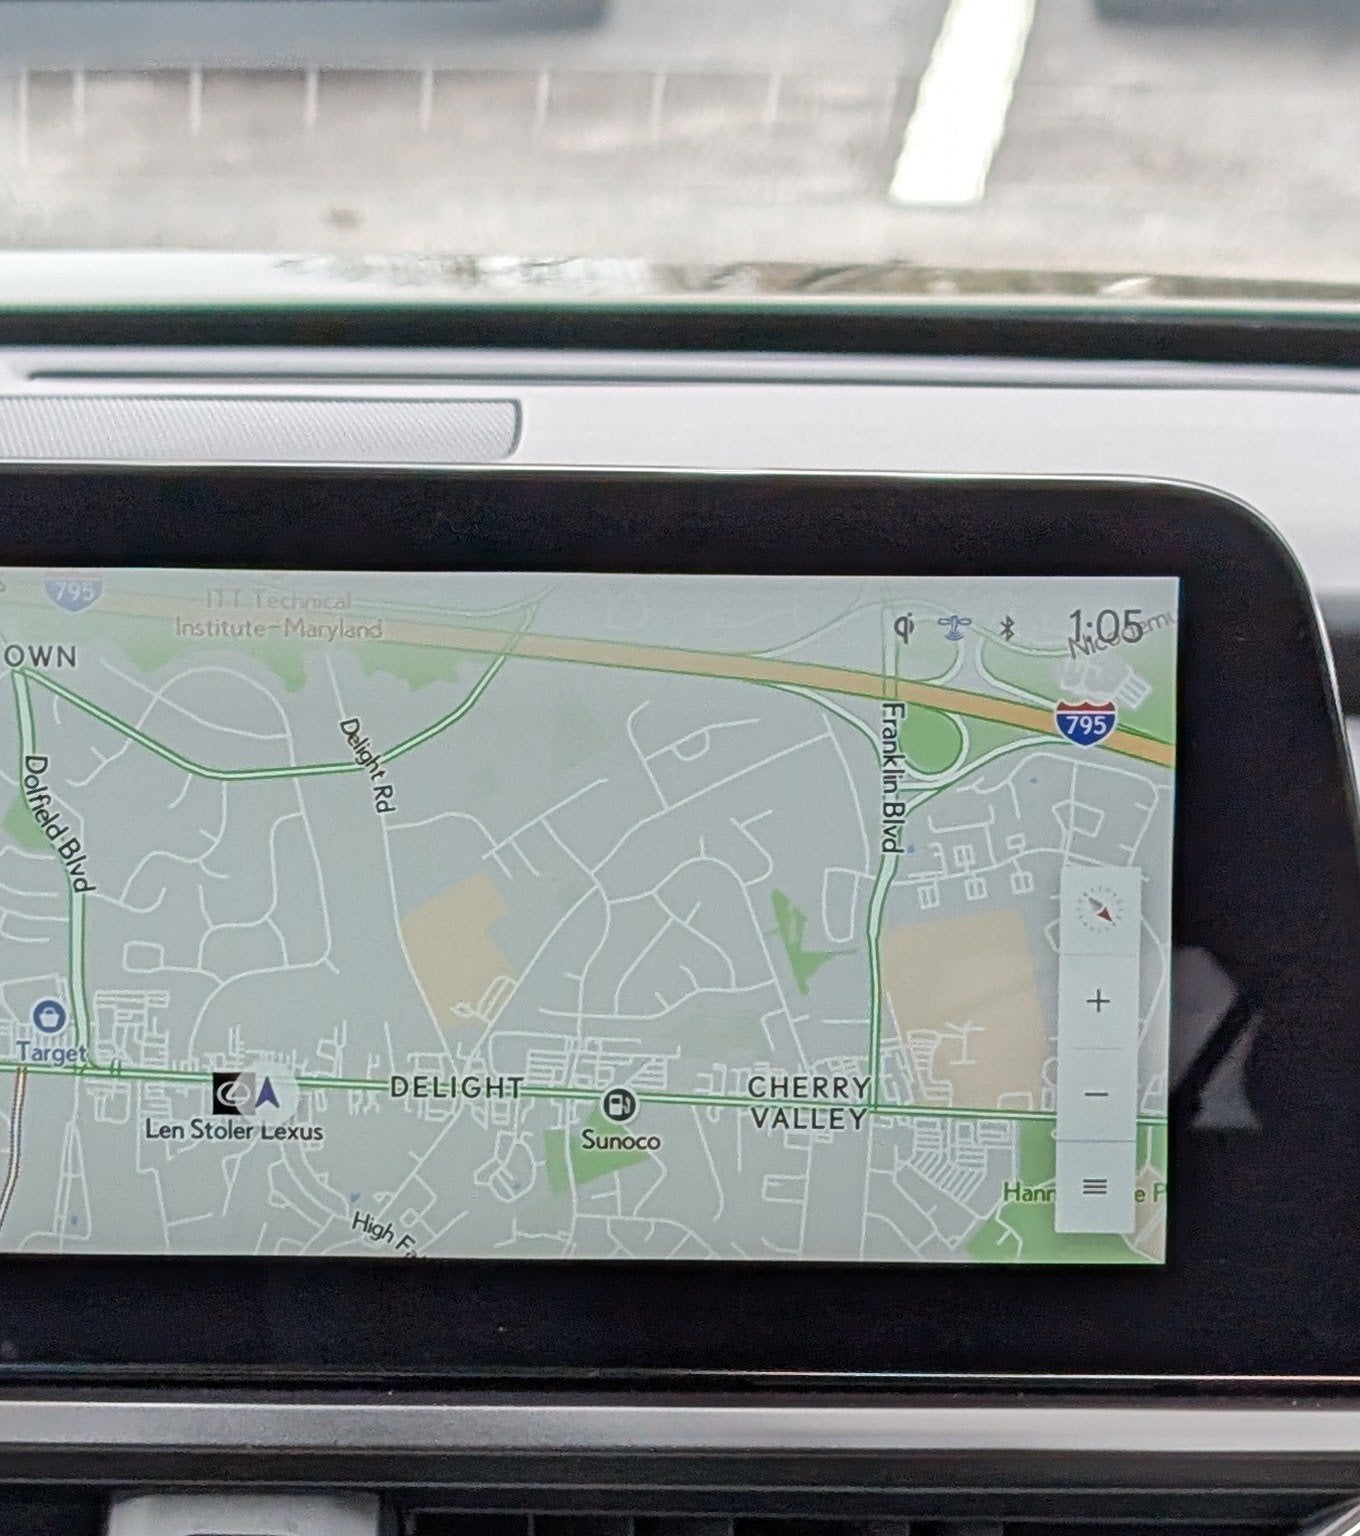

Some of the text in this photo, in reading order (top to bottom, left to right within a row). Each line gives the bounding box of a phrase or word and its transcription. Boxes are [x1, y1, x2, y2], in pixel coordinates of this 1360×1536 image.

[54, 579, 97, 602] 795
[249, 588, 353, 610] Technical
[1069, 608, 1144, 644] 1:05
[1065, 714, 1108, 737] 795
[339, 718, 397, 813] Delight Rd
[881, 702, 906, 854] Franklin Blvd
[23, 754, 98, 893] Dolfield Blvd
[16, 1041, 87, 1067] Target
[390, 1075, 524, 1100] DELIGHT
[747, 1075, 872, 1099] CHERRY
[145, 1118, 324, 1141] Len Stoler Lexus
[750, 1107, 868, 1131] VALLEY
[581, 1131, 661, 1152] Sunoco
[351, 1210, 395, 1244] High
